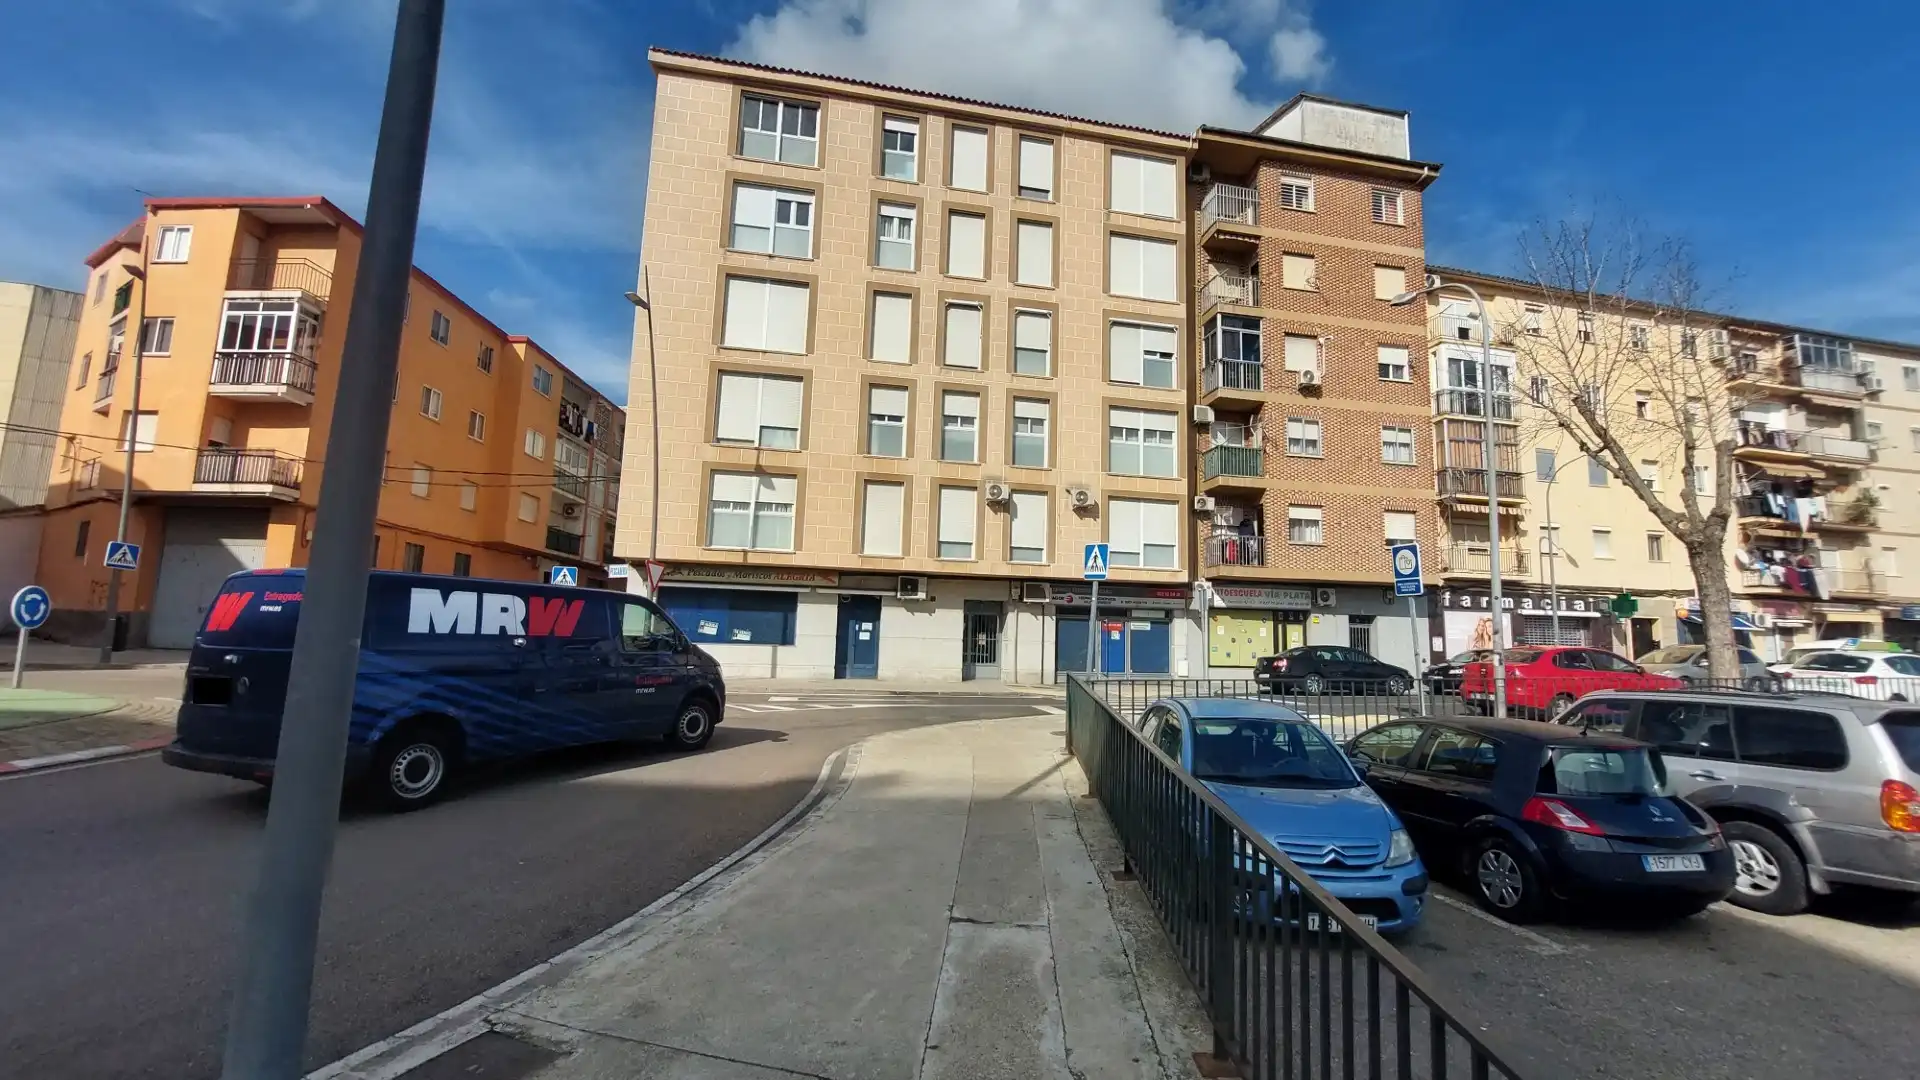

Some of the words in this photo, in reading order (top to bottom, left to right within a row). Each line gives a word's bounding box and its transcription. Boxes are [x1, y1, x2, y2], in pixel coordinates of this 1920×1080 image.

[687, 567, 725, 578] Pescados
[733, 570, 772, 580] Mariscos
[1283, 590, 1311, 602] PLATA
[1442, 590, 1585, 611] farmacia
[407, 587, 586, 636] MRW
[1652, 856, 1677, 870] 1577
